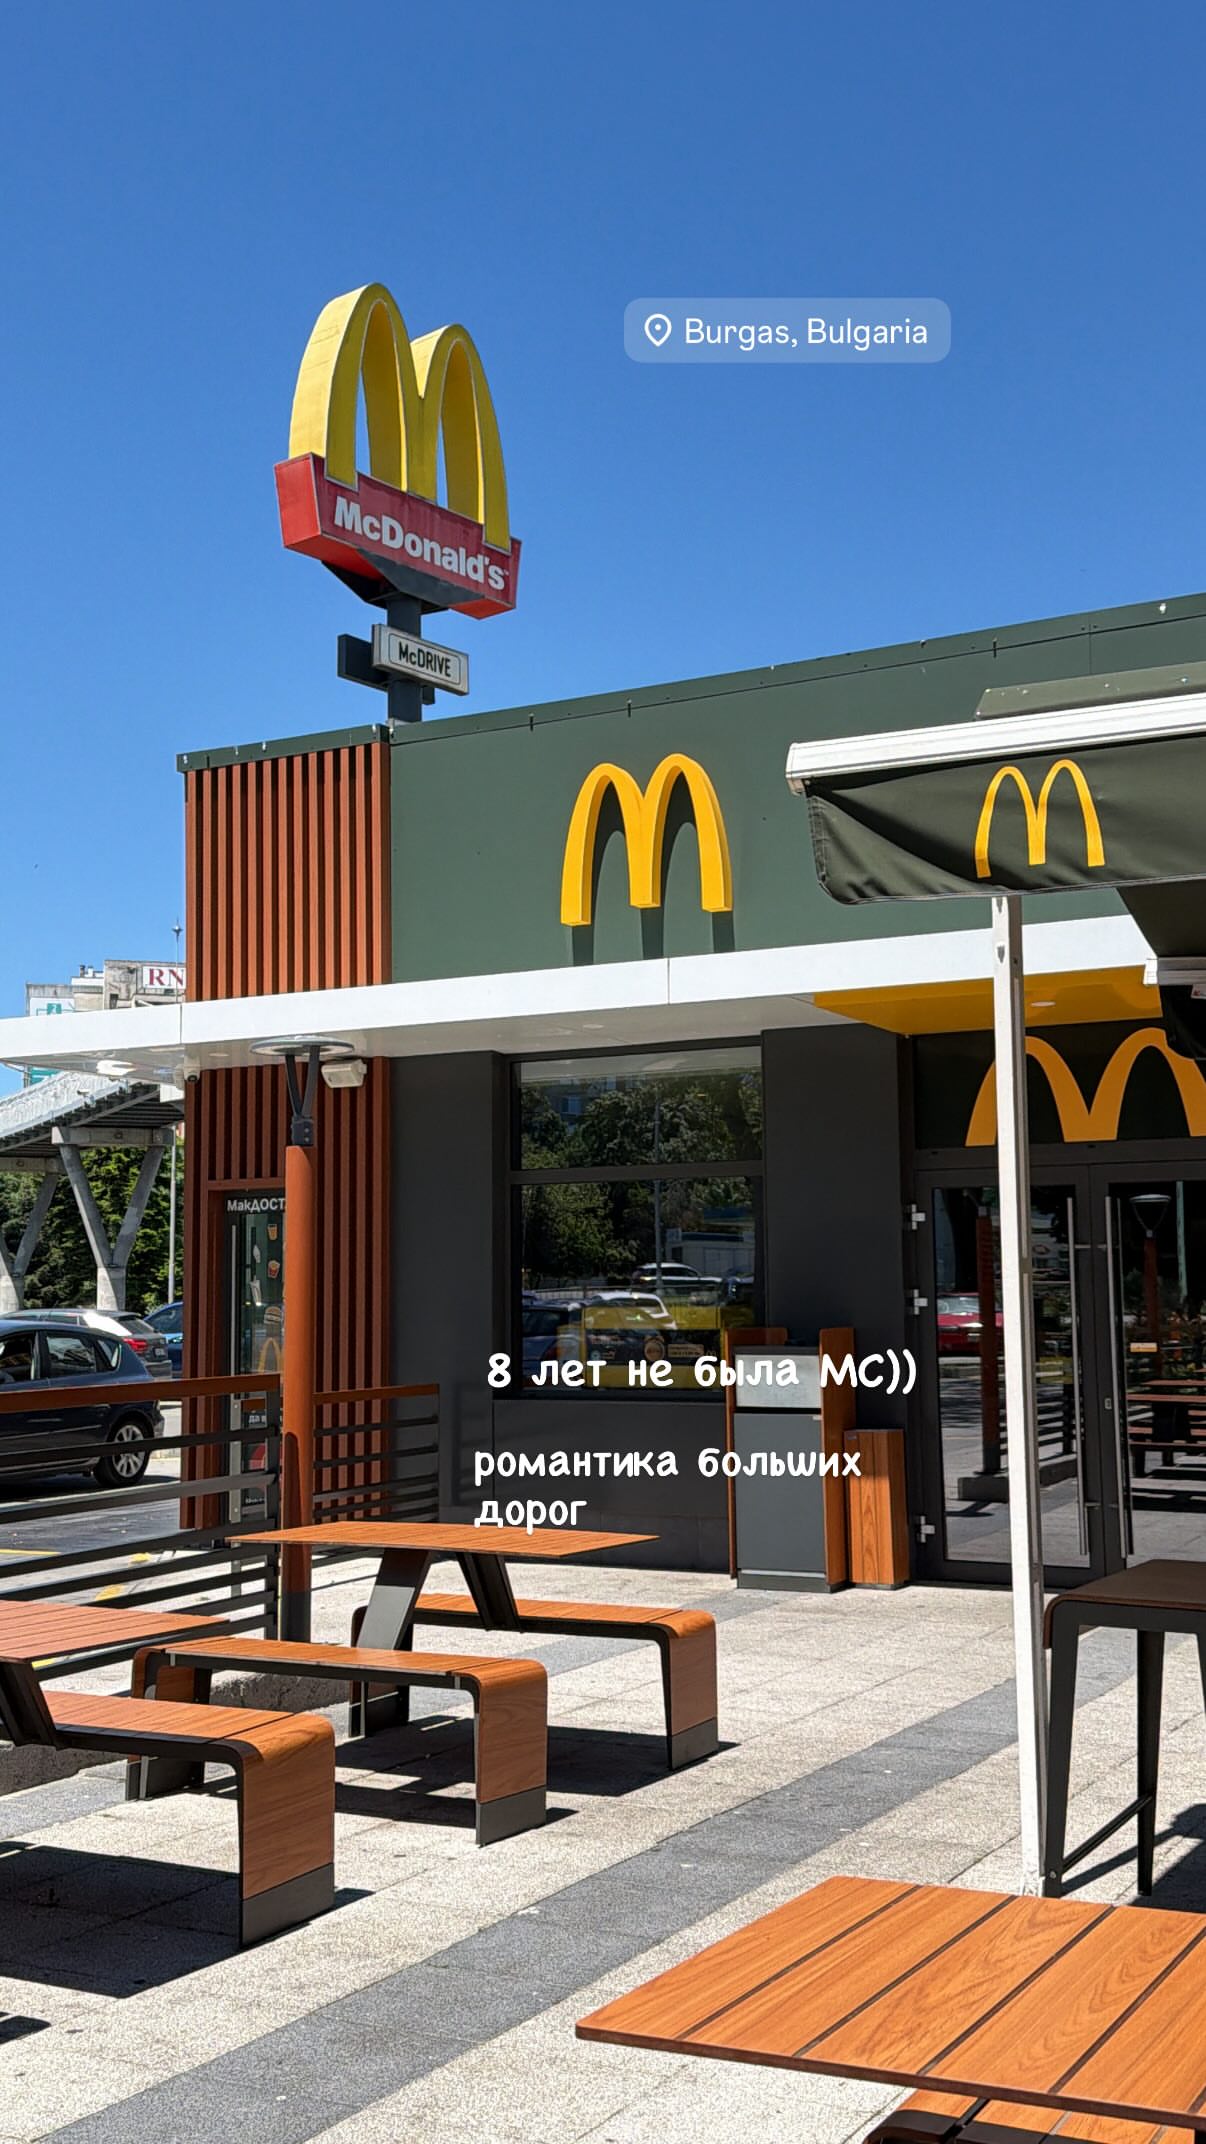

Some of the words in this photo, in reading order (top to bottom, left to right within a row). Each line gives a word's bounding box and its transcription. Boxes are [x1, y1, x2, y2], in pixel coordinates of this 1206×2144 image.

[333, 496, 505, 591] McDonald's
[398, 641, 452, 678] McDRIVE
[227, 1197, 287, 1213] МакДОСТ
